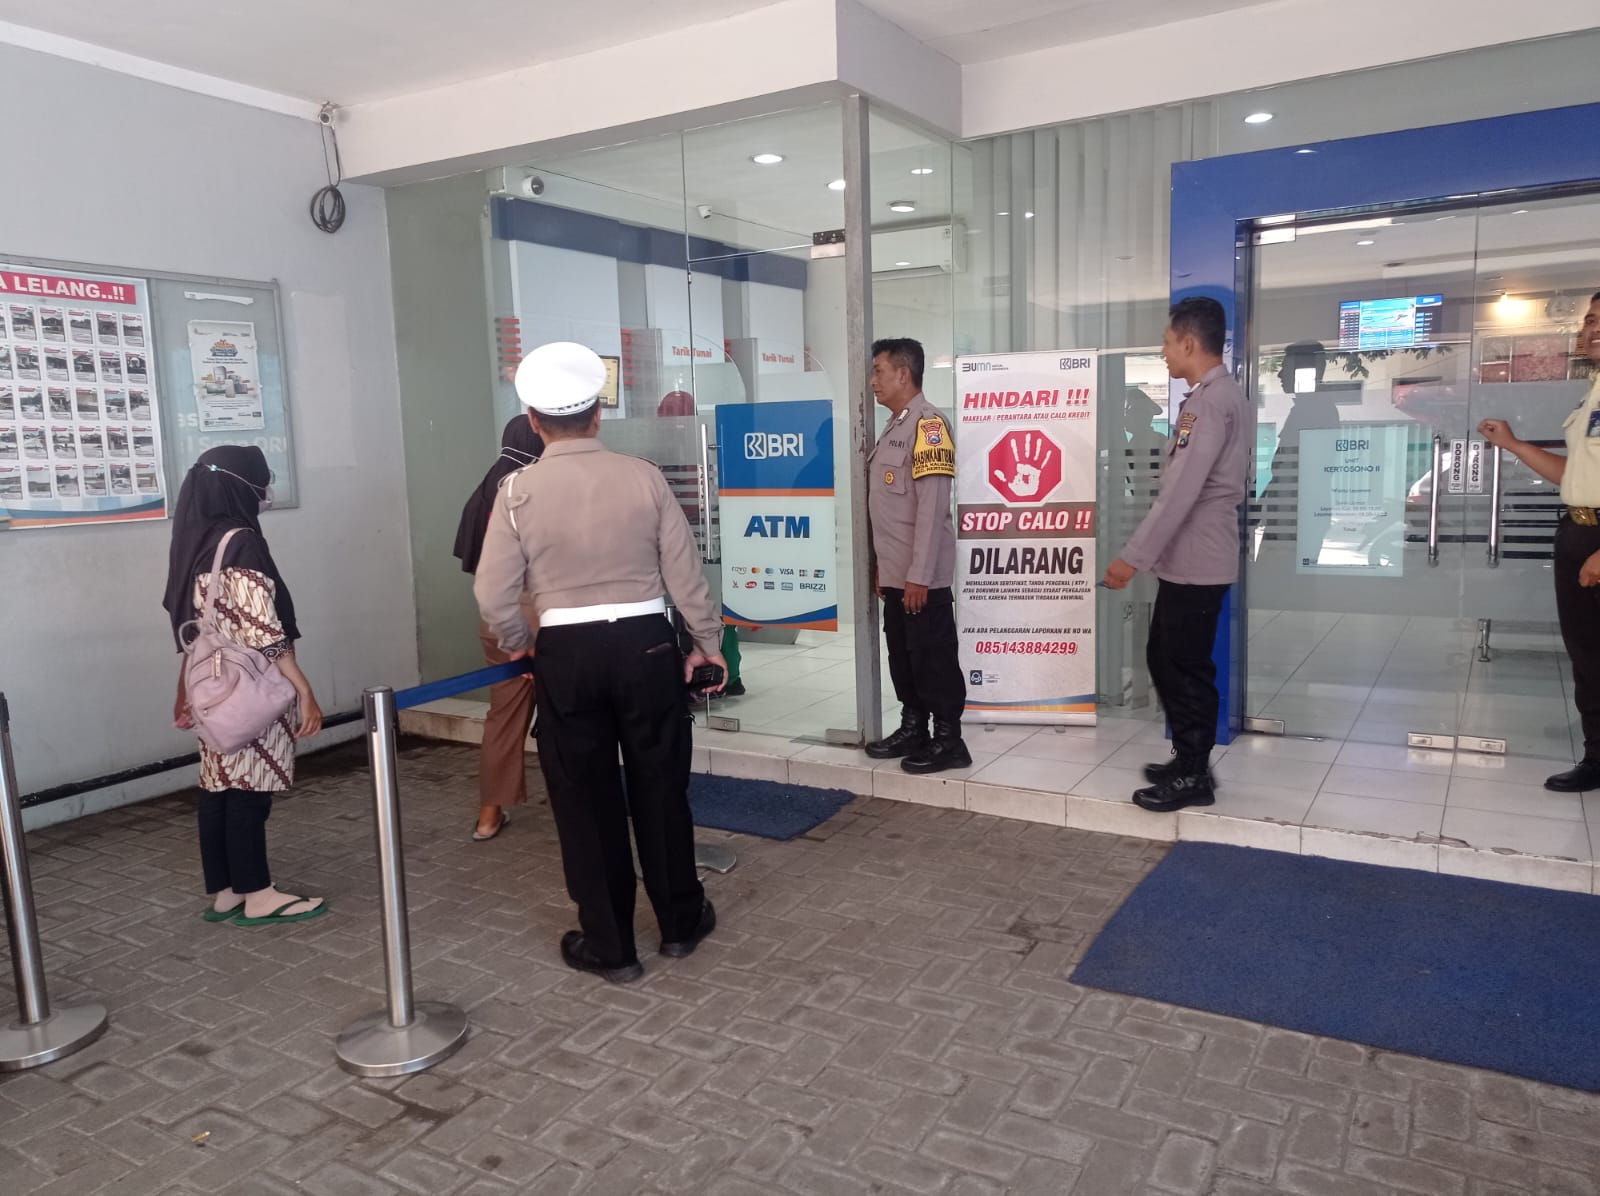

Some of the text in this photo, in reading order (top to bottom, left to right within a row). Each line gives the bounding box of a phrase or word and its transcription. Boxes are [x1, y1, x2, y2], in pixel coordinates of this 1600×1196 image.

[14, 275, 125, 301] LELANG..!!
[1072, 358, 1091, 369] BRI
[963, 389, 1090, 409] HINDARI !!!
[997, 413, 1032, 421] PERANTARA
[767, 433, 804, 457] BRI
[888, 440, 905, 448] POLRI
[1350, 440, 1370, 450] BRI
[1453, 443, 1462, 481] DORONG
[744, 515, 810, 539] ATM
[961, 510, 1092, 532] STOP CALO !!
[969, 546, 1084, 575] DILARANG
[779, 568, 795, 577] VISA
[799, 582, 826, 591] BRIZZI
[975, 641, 1078, 655] 085143884299
